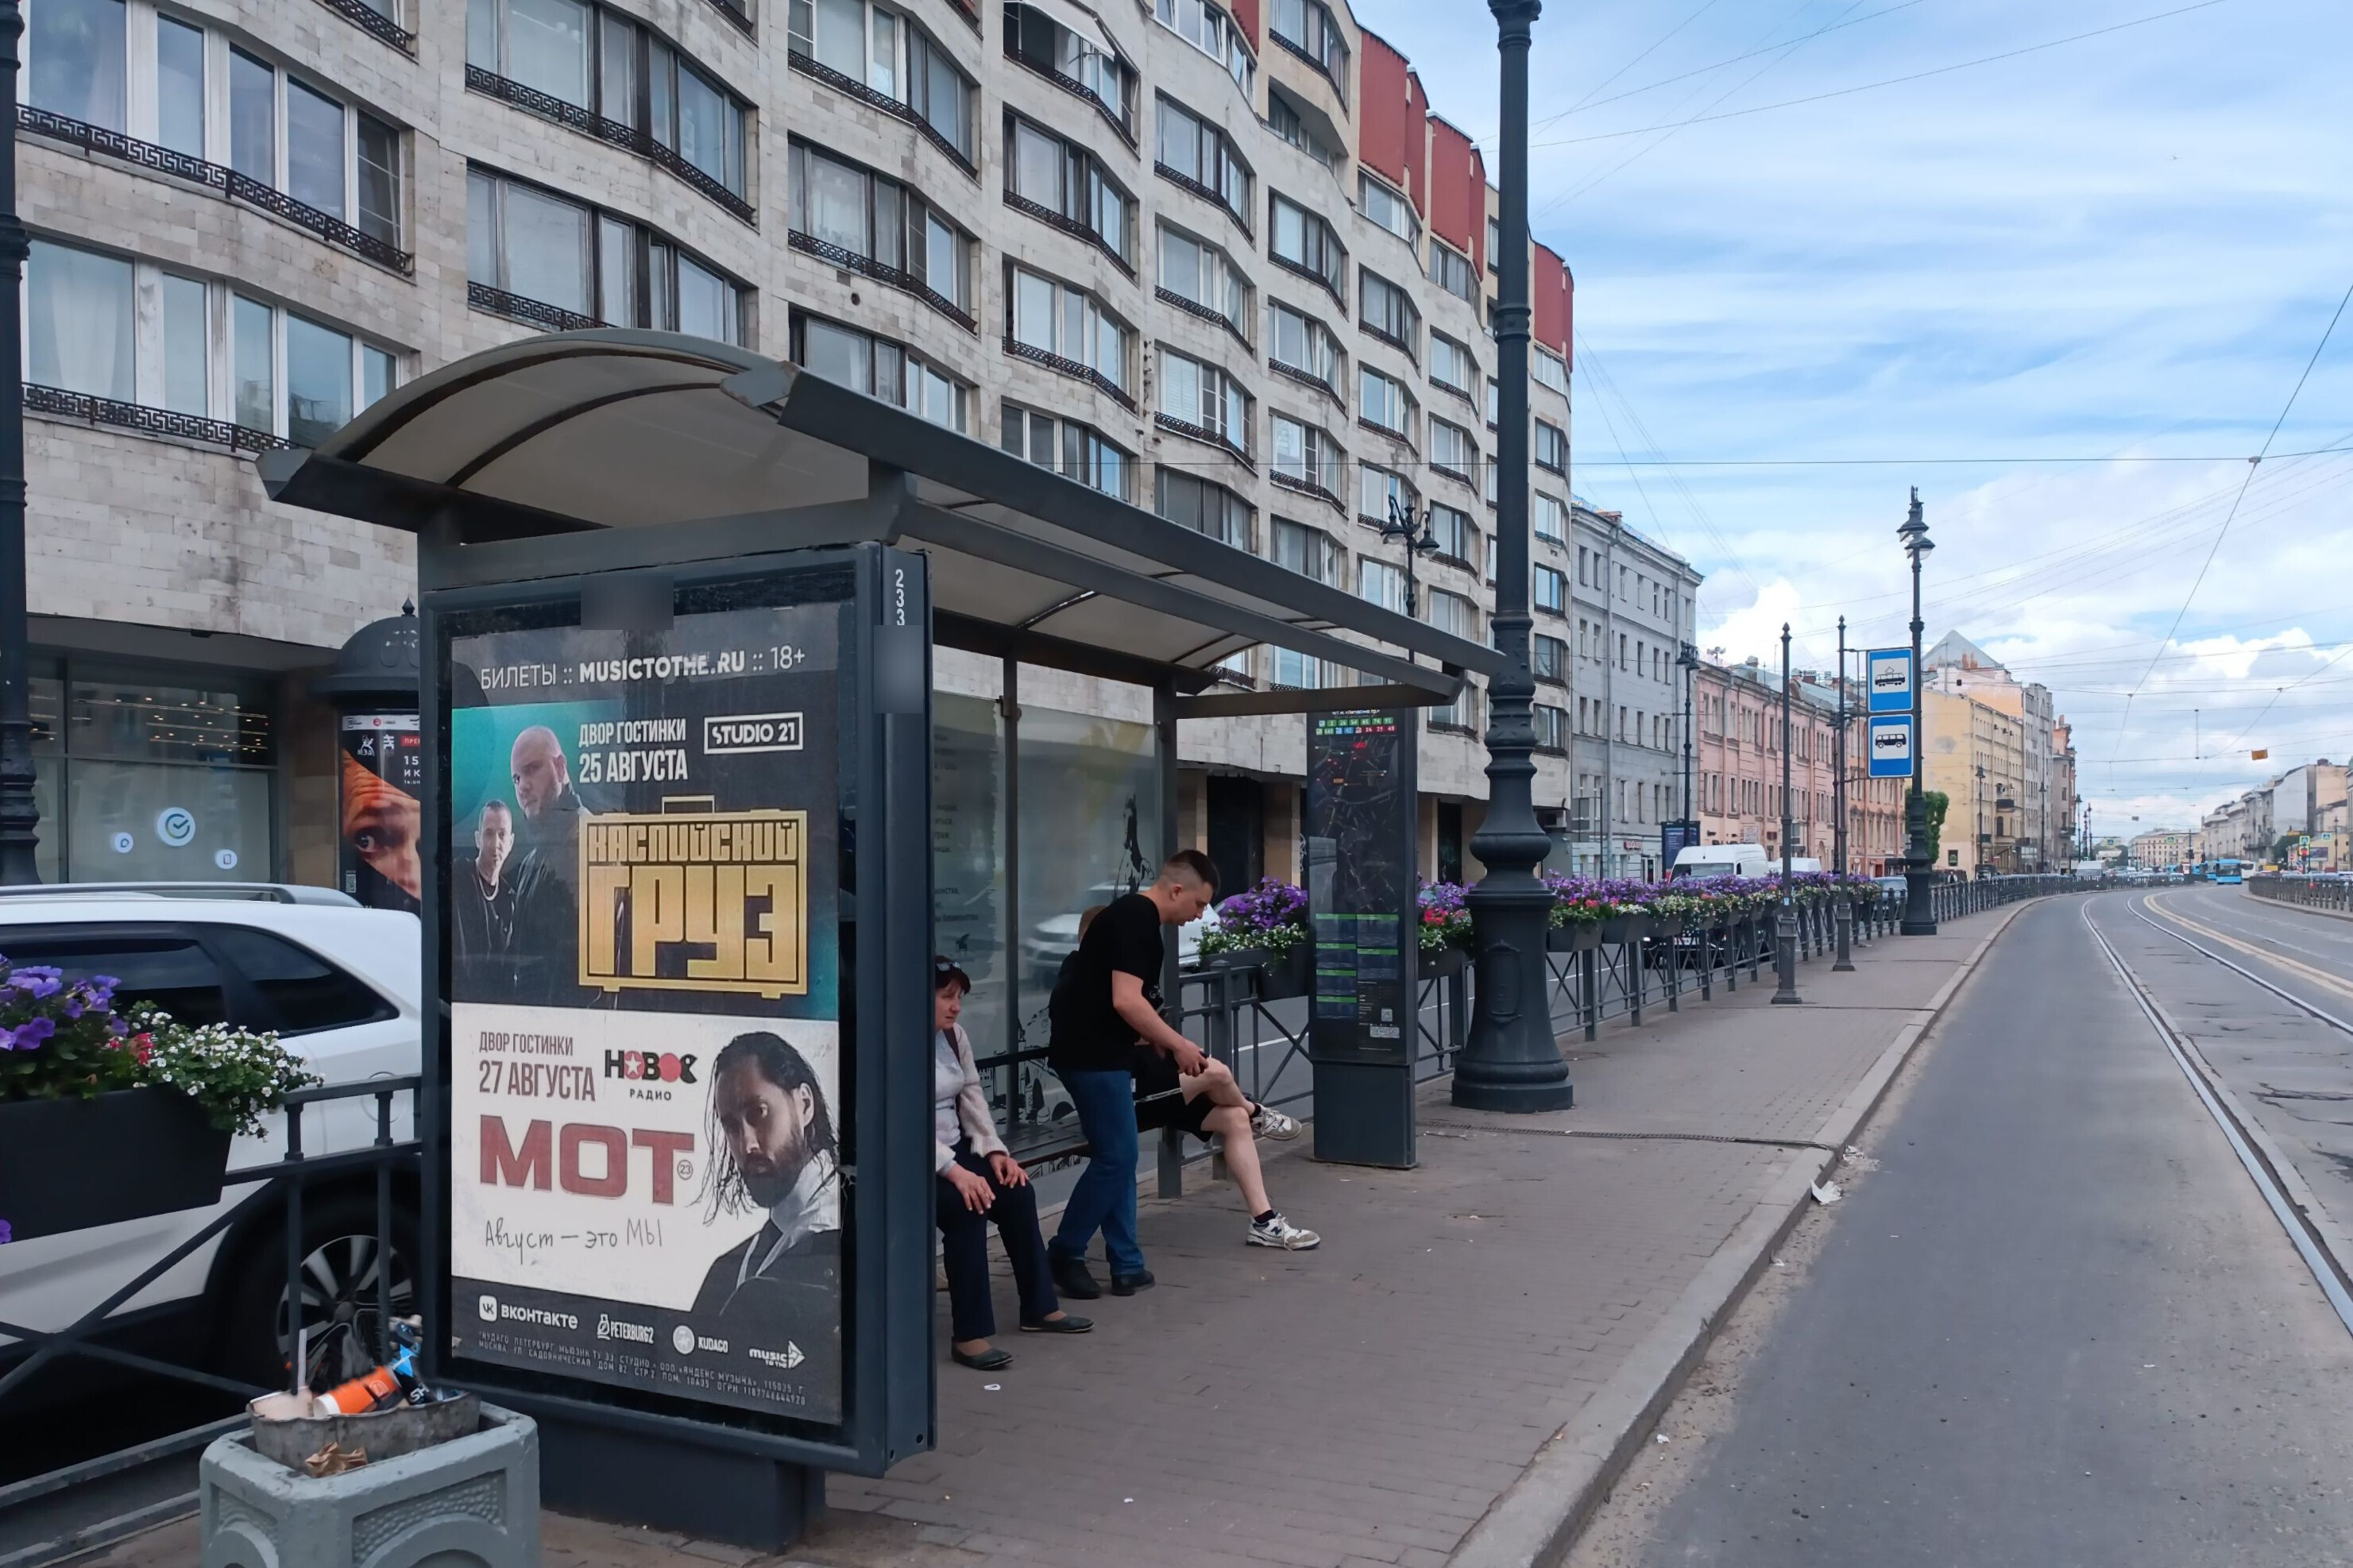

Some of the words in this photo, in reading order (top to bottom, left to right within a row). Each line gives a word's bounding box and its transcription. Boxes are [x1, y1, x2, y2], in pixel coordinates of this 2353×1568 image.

[481, 664, 556, 689] БИЛЕТЫ
[579, 650, 745, 683] MUSICTOTHE.RU
[770, 645, 806, 670] 18+
[578, 723, 614, 748] ДВОР
[617, 718, 686, 743] ГОСТИНКИ
[712, 724, 774, 745] STUDIO
[778, 722, 795, 743] 21
[579, 752, 601, 783] 25
[606, 749, 689, 782] АВГУСТА
[589, 821, 798, 862] КАСПИЙСКИЙ
[589, 864, 798, 981] ГРУЗ
[479, 1031, 510, 1053] ДВОР
[512, 1033, 574, 1056] ГОСТИНКИ
[479, 1060, 503, 1095] 27
[508, 1062, 597, 1102] АВГУСТА
[629, 1089, 672, 1102] РАДИО
[480, 1114, 695, 1207] МОТ
[680, 1164, 691, 1175] 23
[485, 1217, 554, 1265] Август
[585, 1230, 618, 1249] это
[626, 1218, 663, 1247] МЫ
[514, 1337, 555, 1351] ПЕТЕРБУРГ
[597, 1361, 614, 1372] ДОМ
[717, 1381, 738, 1395] ОГРН
